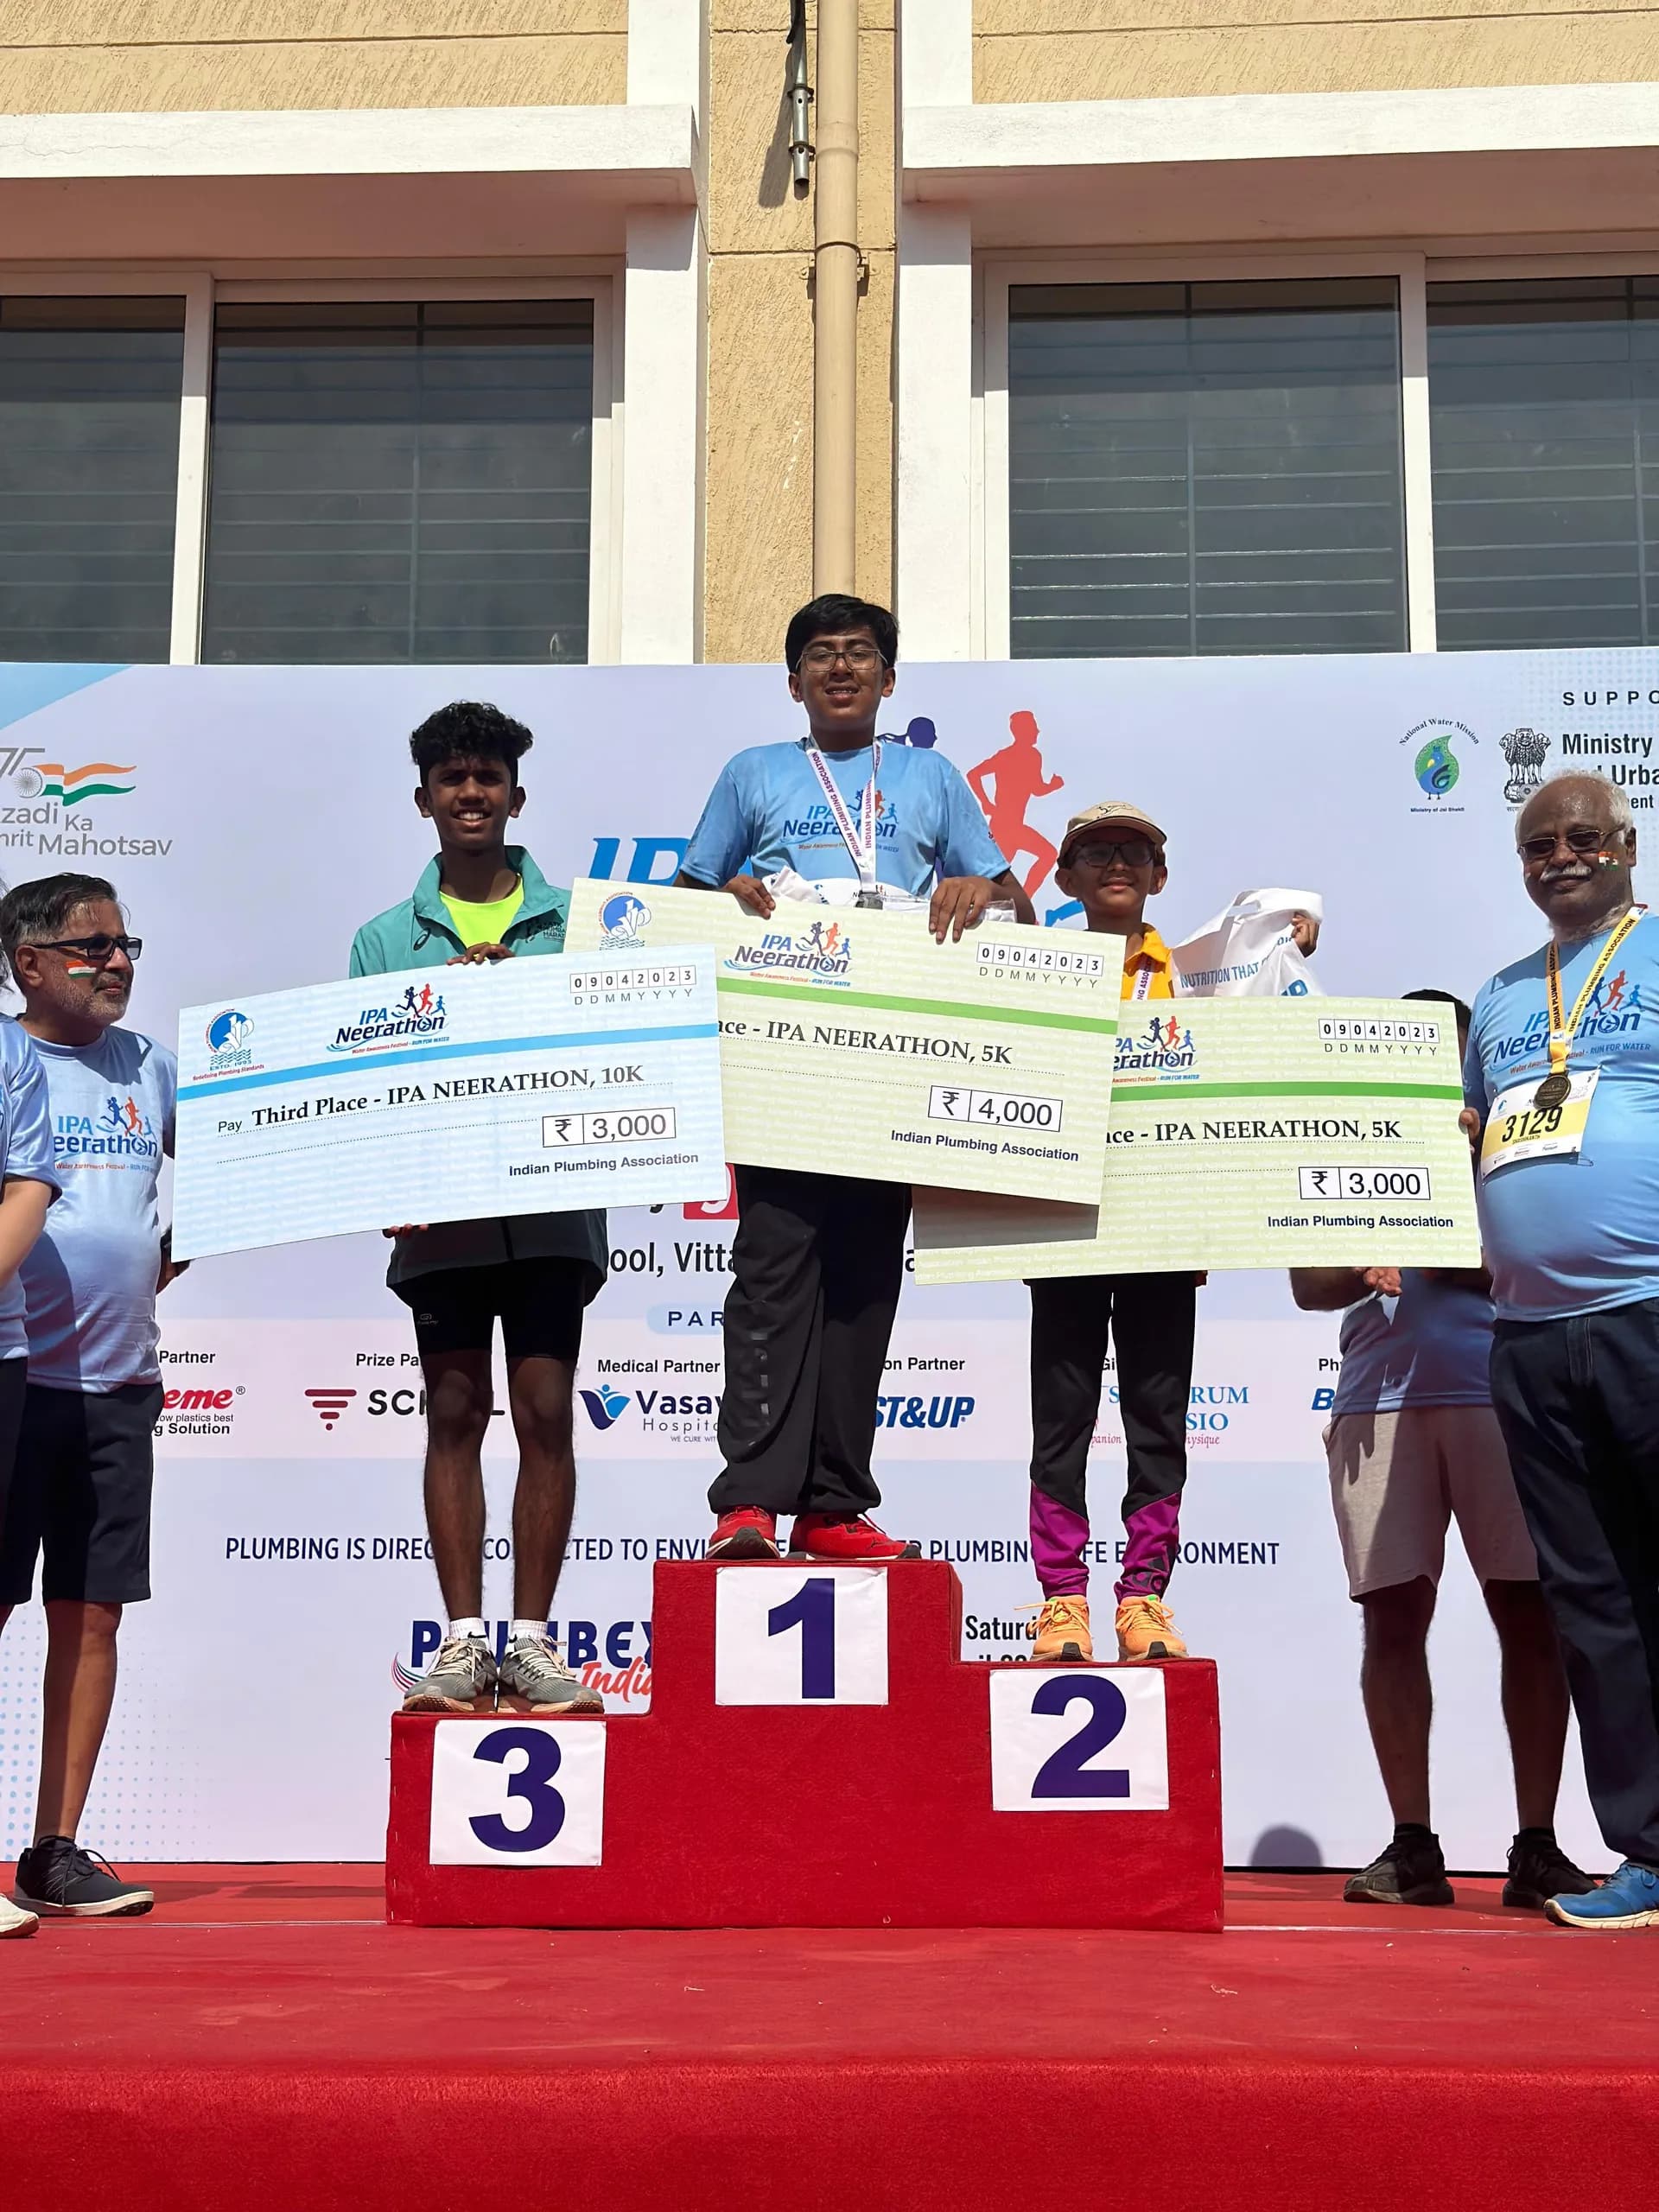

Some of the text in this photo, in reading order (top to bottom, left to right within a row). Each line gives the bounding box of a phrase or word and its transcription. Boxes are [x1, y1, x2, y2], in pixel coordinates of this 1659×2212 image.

[1561, 733, 1653, 759] Ministry
[1628, 794, 1654, 809] ent
[2, 802, 93, 831] zadi Ka
[38, 833, 173, 856] Mahotsav
[760, 934, 792, 951] IPA
[734, 945, 849, 974] Neerathon
[1180, 962, 1260, 988] NUTRITION THAT
[359, 1007, 388, 1026] IPA
[335, 1015, 445, 1045] Neerathon
[766, 1020, 806, 1042] IPA
[812, 1026, 976, 1064] NEERATHON,
[981, 1045, 1013, 1065] 5K
[1116, 1037, 1134, 1053] PA
[1605, 1043, 1620, 1052] FOR
[1621, 1042, 1651, 1052] WATER
[218, 1120, 243, 1134] Pay
[251, 1101, 308, 1127] Third
[315, 1094, 368, 1116] Place
[387, 1084, 426, 1105] IPA
[433, 1068, 595, 1101] NEERATHON,
[601, 1065, 644, 1084] 10K
[978, 1098, 1052, 1126] 4,000
[57, 1116, 94, 1135] IPA
[592, 1114, 666, 1141] 3,000
[1154, 1122, 1197, 1141] IPA
[1202, 1120, 1367, 1141] NEERATHON,
[1371, 1121, 1402, 1139] 5K
[1501, 1106, 1563, 1143] 3129
[54, 1135, 158, 1158] eerathon
[891, 1129, 1079, 1162] Indian Plumbing Association
[509, 1153, 699, 1176] Indian Plumbing Association
[1349, 1173, 1421, 1198] 3,000
[1268, 1215, 1454, 1229] Indian Plumbing Association
[608, 1242, 664, 1277] ool,
[667, 1311, 724, 1327] PAR
[159, 1350, 216, 1363] Partner
[355, 1353, 395, 1367] Prize
[597, 1358, 721, 1374] Medical Partner
[907, 1357, 965, 1371] Partner
[163, 1389, 234, 1410] eme
[168, 1422, 231, 1434] Solution
[175, 1414, 212, 1424] plastics
[213, 1414, 234, 1422] best
[1185, 1412, 1229, 1431] SIO
[226, 1537, 339, 1560] PLUMBING
[346, 1537, 365, 1560] IS
[620, 1538, 648, 1561] TO
[656, 1538, 706, 1560] ENVI
[931, 1540, 1028, 1563] PLUMBIN
[768, 1578, 836, 1700] 1
[1031, 1675, 1130, 1799] 2
[468, 1726, 565, 1853] 3
